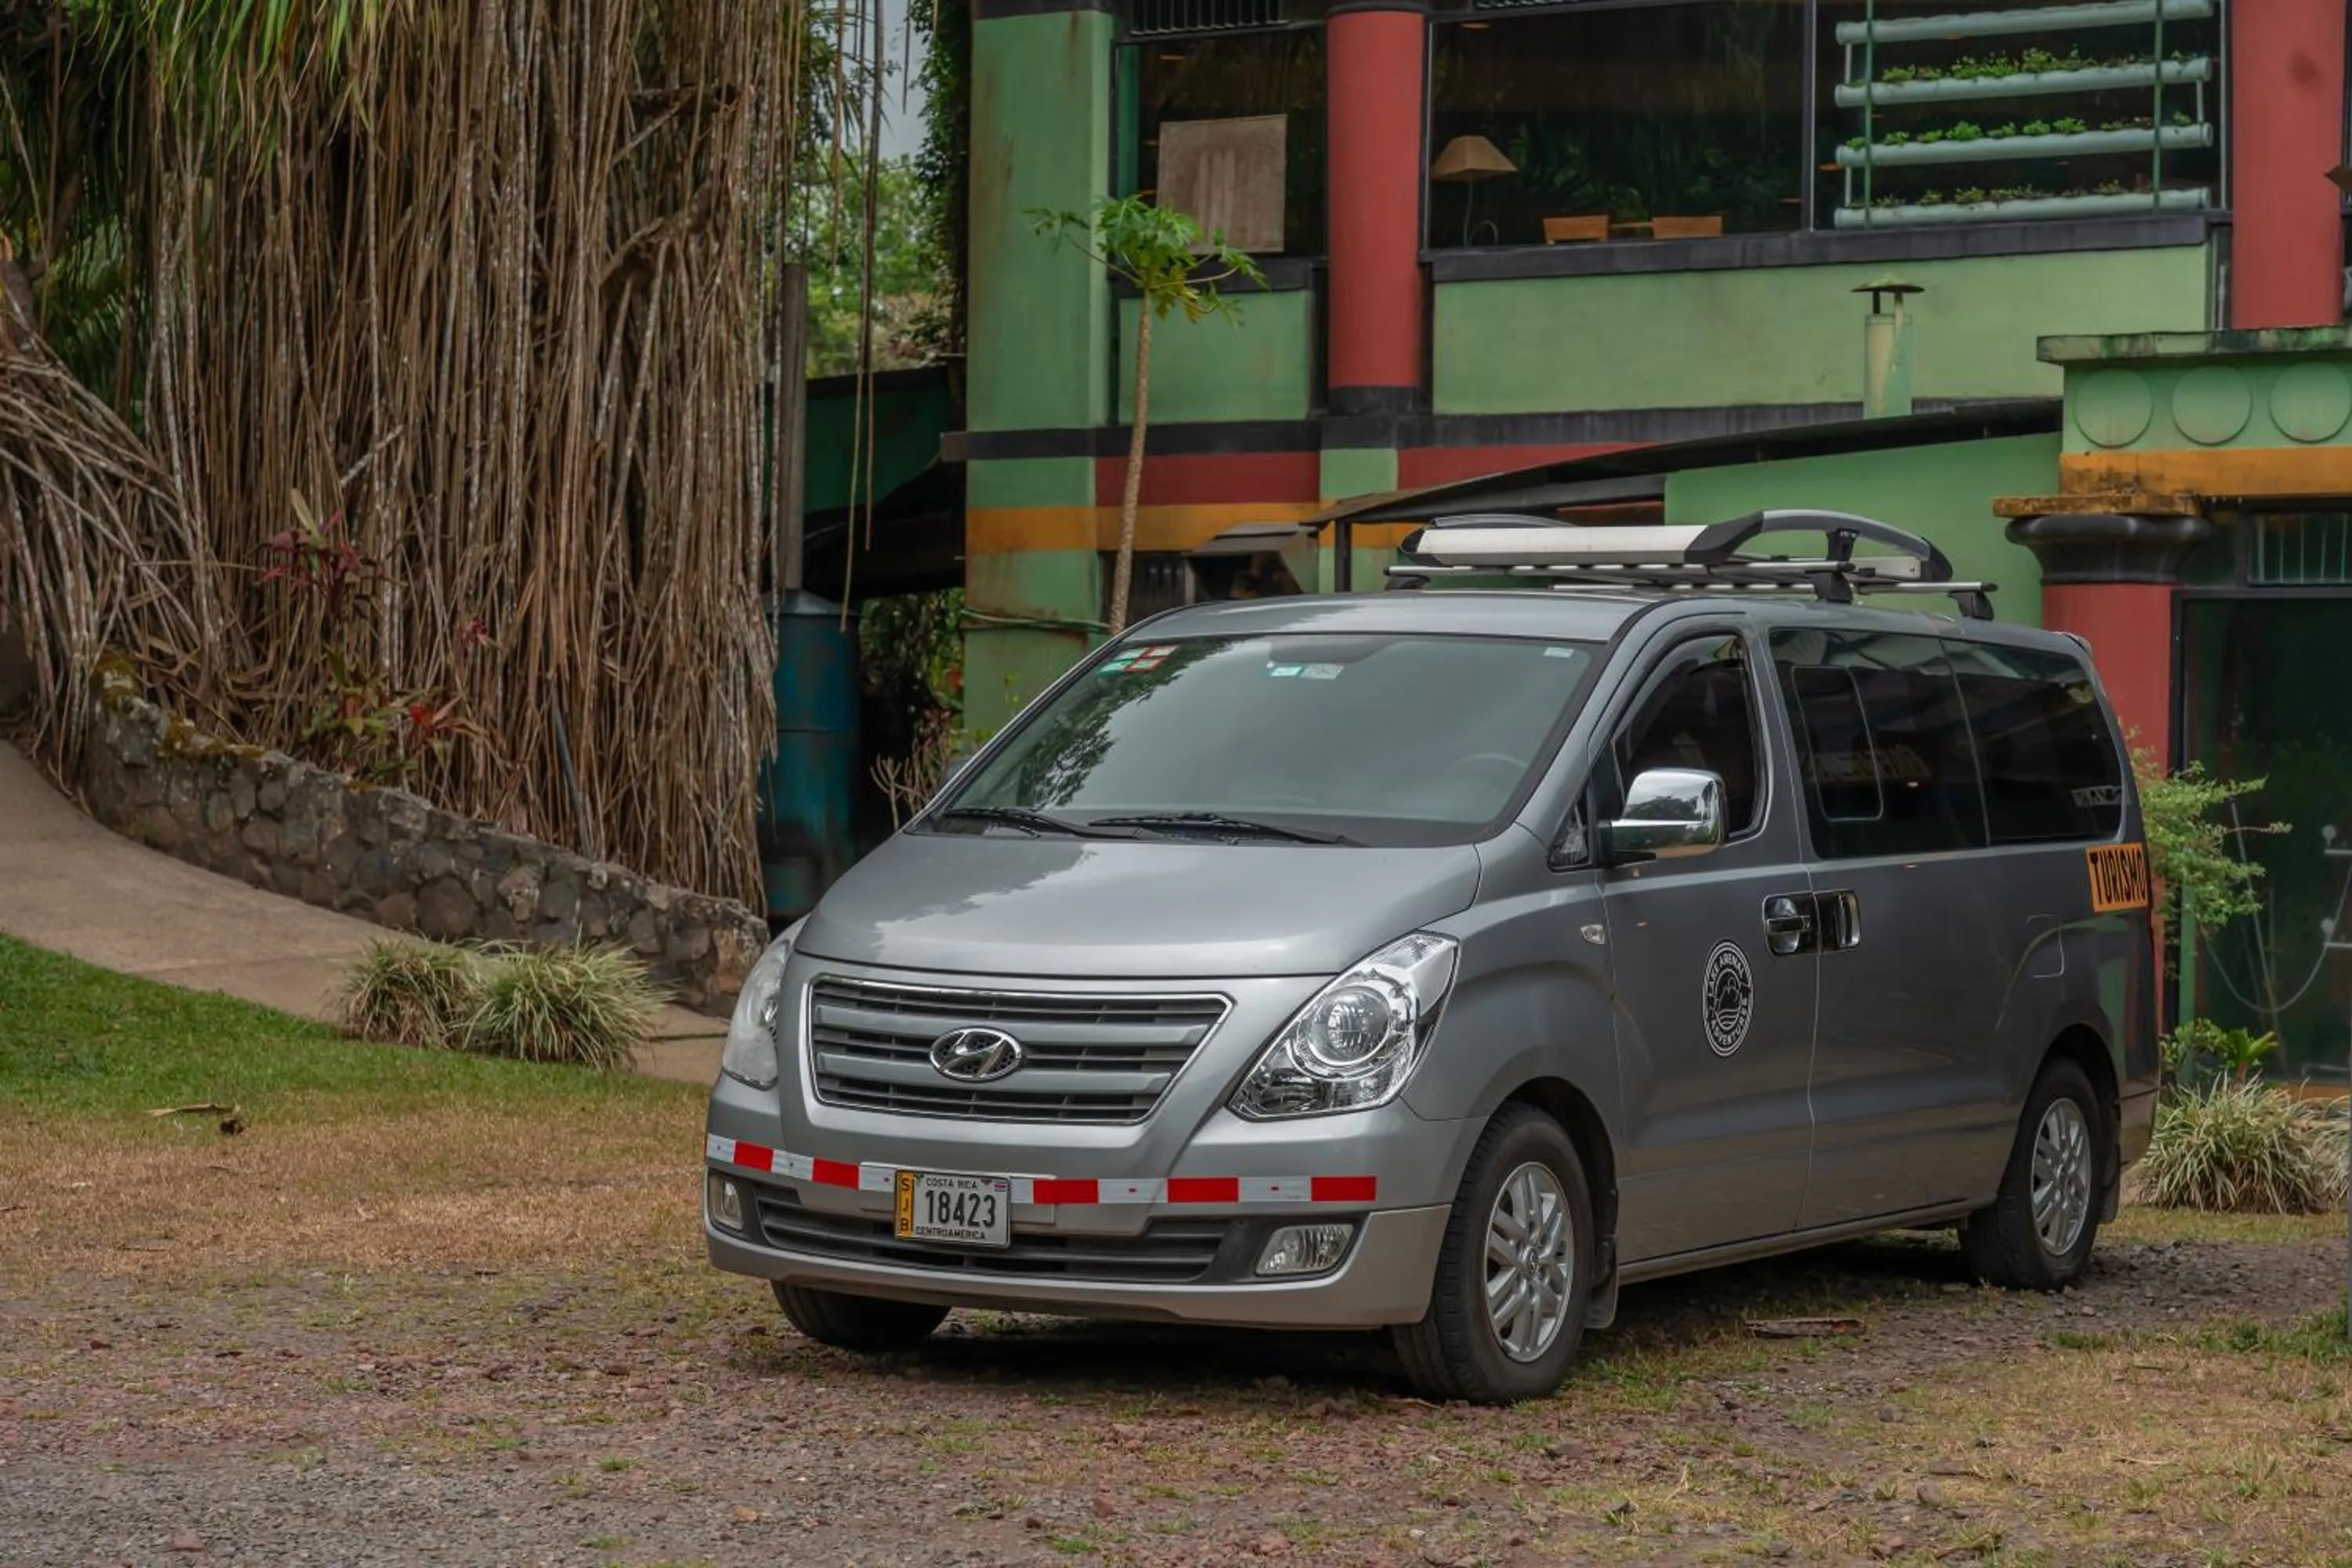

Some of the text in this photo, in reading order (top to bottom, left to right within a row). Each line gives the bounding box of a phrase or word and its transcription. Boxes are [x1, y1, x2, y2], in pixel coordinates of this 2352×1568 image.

[2089, 849, 2146, 904] TURISMO
[1719, 953, 1744, 979] ARENAL
[926, 1178, 978, 1189] COSTA RICA
[925, 1189, 996, 1229] 18423
[916, 1225, 985, 1240] CENTROAMERICA
